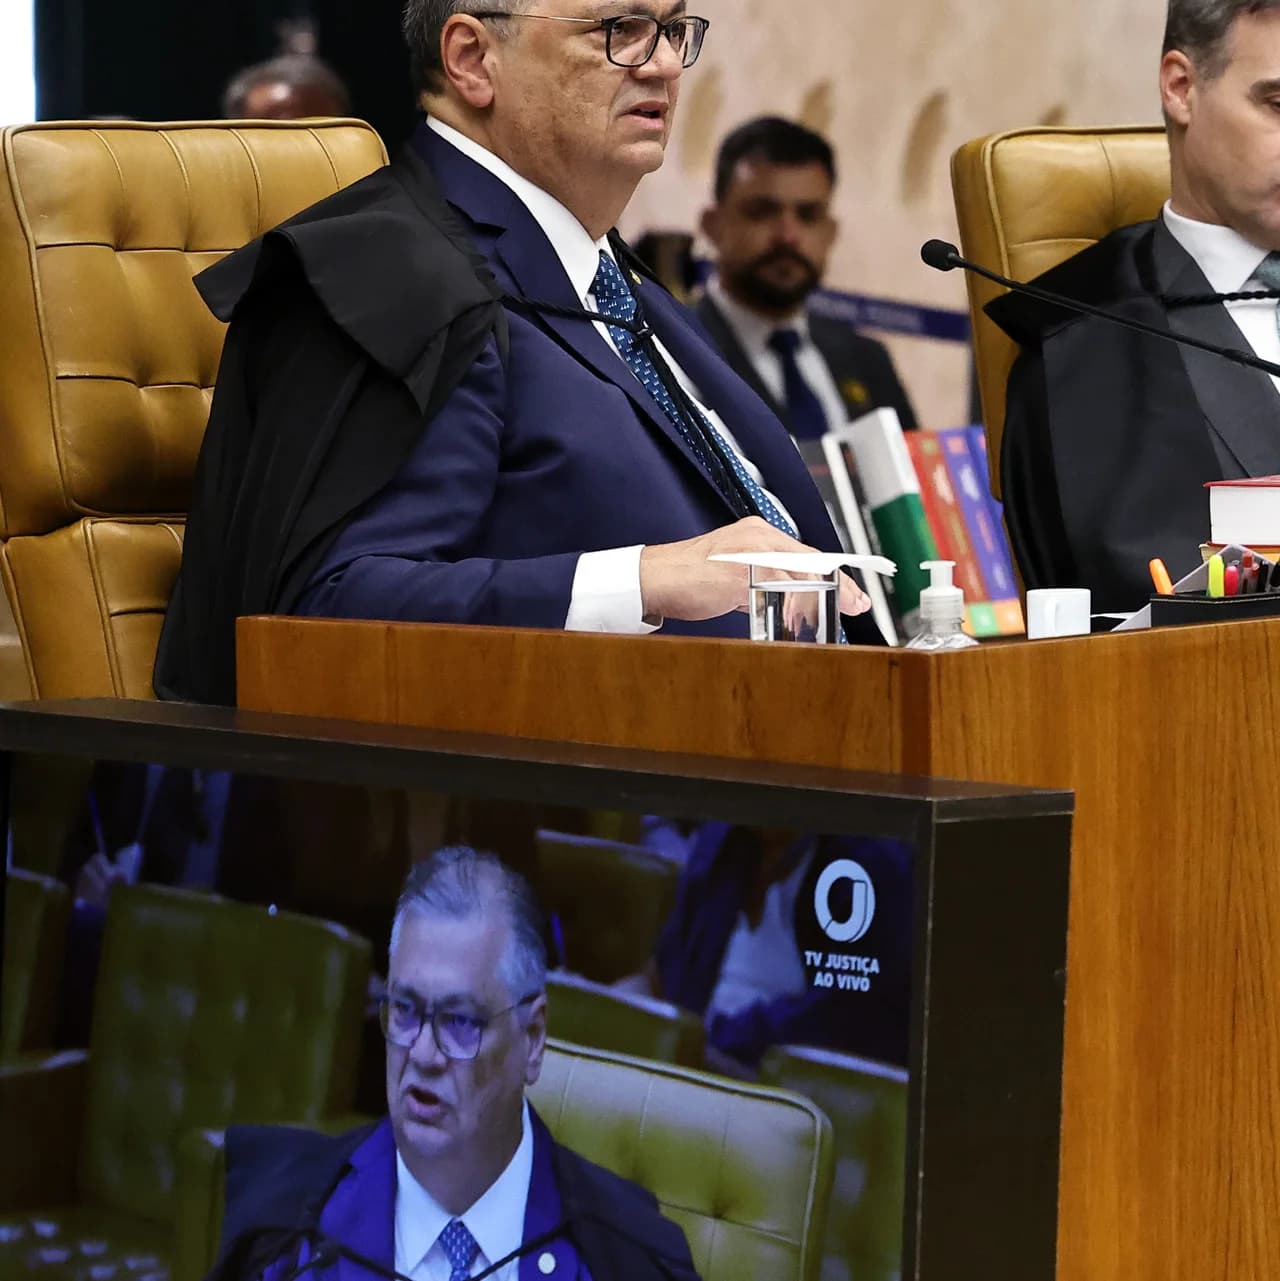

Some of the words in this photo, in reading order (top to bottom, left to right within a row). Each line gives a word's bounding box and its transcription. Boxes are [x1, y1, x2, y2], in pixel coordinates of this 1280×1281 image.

[805, 950, 823, 967] TV
[825, 953, 880, 976] JUSTIÇA
[814, 971, 834, 988] AO
[837, 973, 870, 992] VIVO
